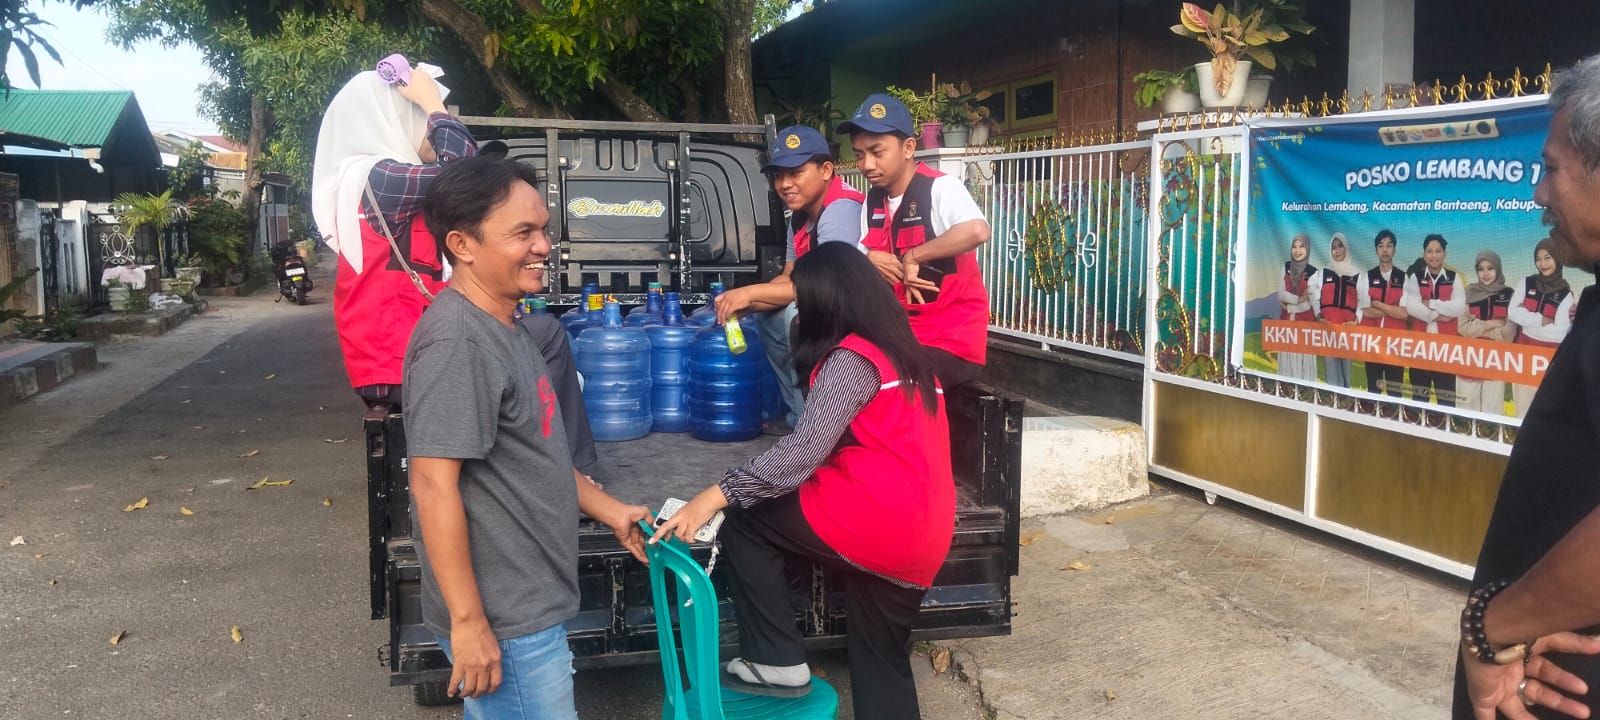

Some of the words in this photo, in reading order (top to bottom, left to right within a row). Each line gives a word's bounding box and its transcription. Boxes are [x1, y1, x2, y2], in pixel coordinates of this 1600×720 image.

[1345, 162, 1410, 191] POSKO
[1415, 158, 1524, 183] LEMBANG
[1531, 163, 1541, 185] 1
[1282, 201, 1322, 212] Kelurahan
[1323, 201, 1369, 214] Lembang,
[1372, 200, 1431, 212] Kecamatan
[1433, 199, 1492, 213] Bantaeng,
[1264, 326, 1298, 345] KKN
[1302, 328, 1382, 354] TEMATIK
[1386, 336, 1523, 374] KEAMANAN
